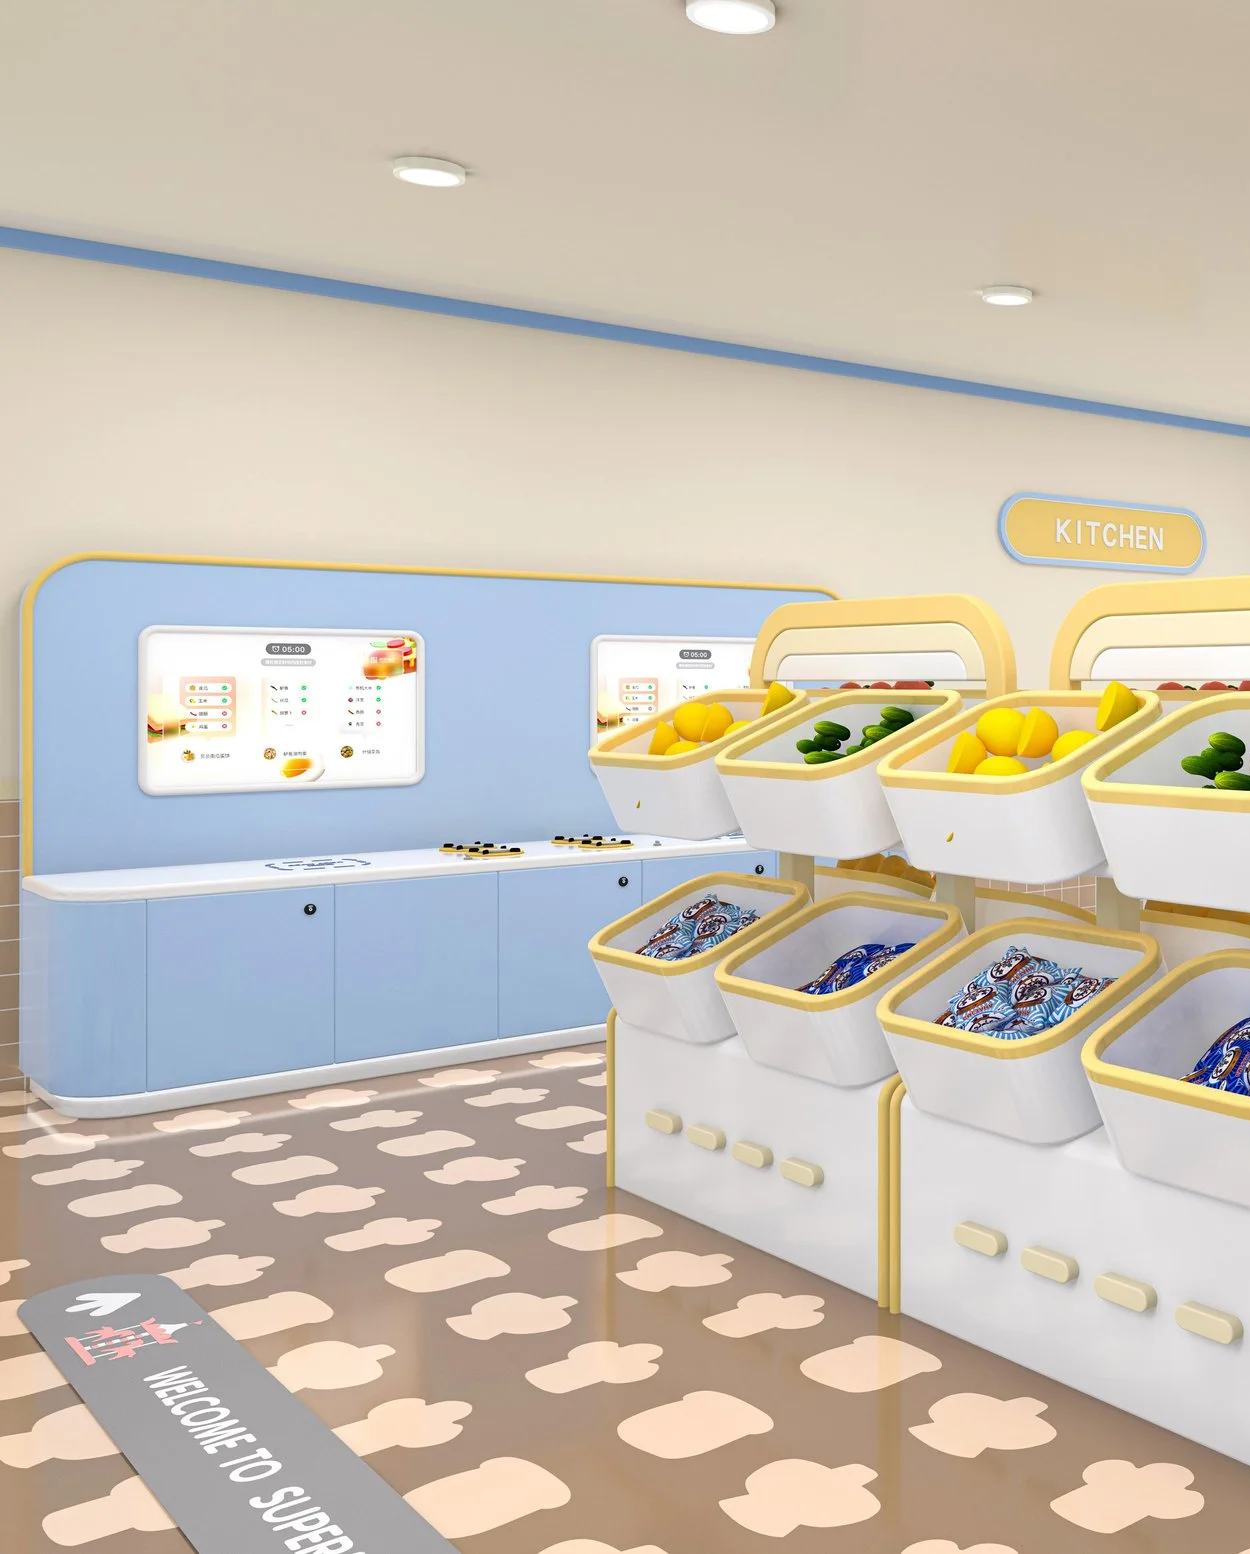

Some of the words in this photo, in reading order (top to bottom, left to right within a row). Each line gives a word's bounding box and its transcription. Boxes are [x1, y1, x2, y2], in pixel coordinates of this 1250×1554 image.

[1055, 518, 1164, 551] KITCHEN
[282, 645, 306, 653] 05:00
[143, 1365, 257, 1455] WELCOME
[219, 1447, 283, 1483] TO
[248, 1486, 367, 1554] SUPER
